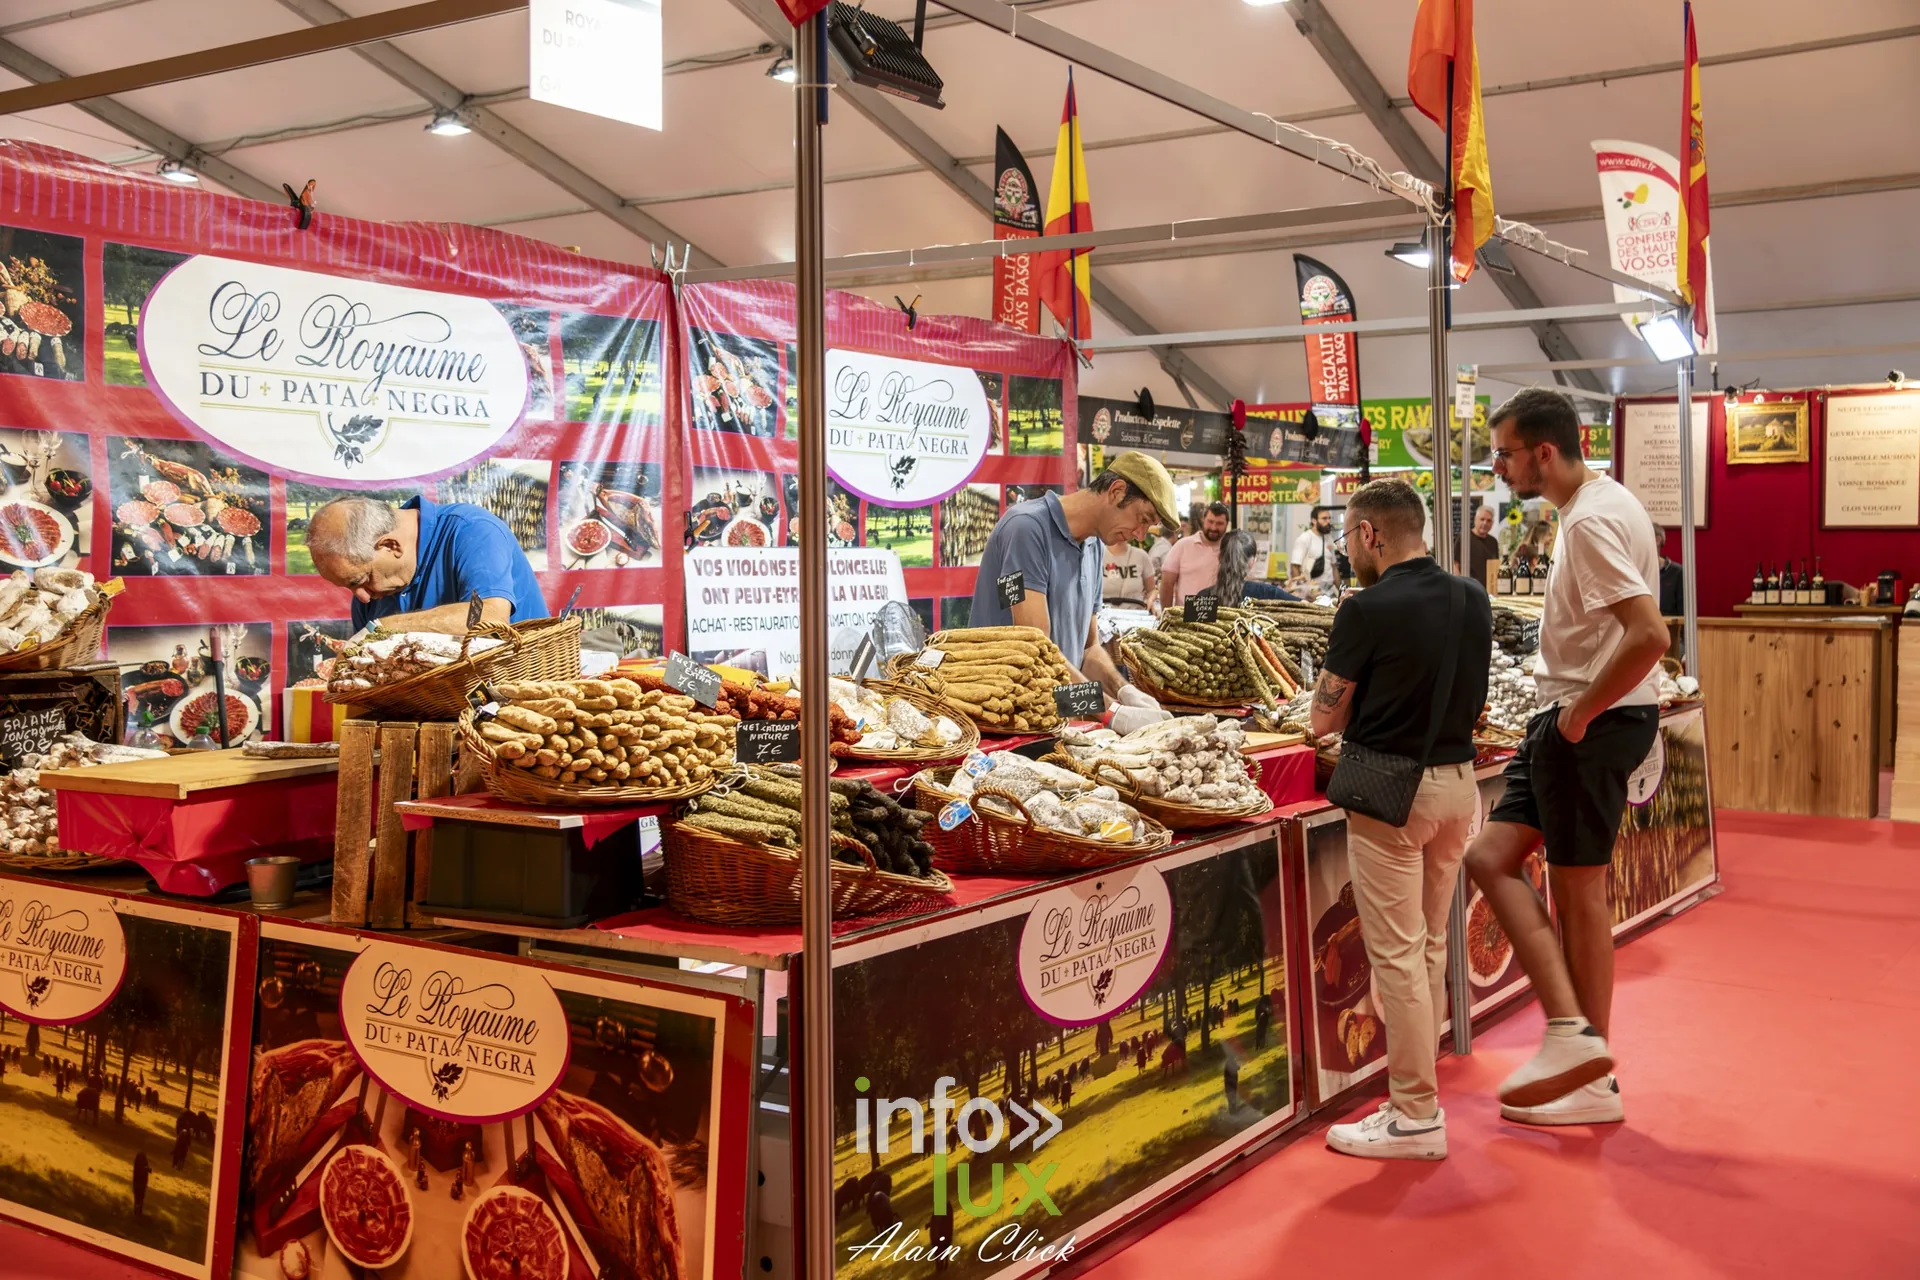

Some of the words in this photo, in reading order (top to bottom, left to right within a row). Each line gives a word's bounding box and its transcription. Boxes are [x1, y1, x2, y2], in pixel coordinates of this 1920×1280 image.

[543, 28, 562, 48] DU
[1599, 157, 1657, 172] www.cdhv.fr
[1616, 230, 1677, 247] CONFISER
[1618, 246, 1640, 258] DES
[1642, 240, 1677, 255] HAUT
[1620, 253, 1677, 271] VOSGE
[198, 280, 284, 361] Le
[295, 293, 488, 406] Royaume
[1339, 368, 1350, 393] PAYS
[200, 371, 251, 399] DU
[281, 379, 358, 408] PATA
[387, 389, 490, 418] NEGRA
[829, 364, 871, 420] Le
[876, 370, 971, 450] Royaume
[830, 428, 854, 446] DU
[867, 431, 905, 451] PATA
[919, 436, 969, 456] NEGRA
[1379, 438, 1392, 450] RY
[1236, 490, 1300, 503] EMPORTER
[694, 559, 722, 576] VOS
[727, 559, 786, 576] VIOLONS
[789, 560, 800, 576] E
[829, 559, 888, 576] LONCELLES
[702, 587, 730, 605] ONT
[734, 586, 800, 604] PEUT-ETR
[832, 585, 847, 601] LA
[851, 584, 889, 601] VALEUR
[691, 617, 727, 633] ACHAT
[734, 615, 800, 632] RESTAURATIO
[1532, 636, 1539, 646] 3
[831, 648, 855, 661] donn
[1069, 688, 1097, 699] EXTRA
[749, 732, 790, 742] NATURE
[1039, 906, 1075, 963] Le
[1077, 886, 1156, 964] Royaume
[16, 900, 106, 971] Royaume
[8, 951, 41, 972] PATA
[52, 960, 103, 985] NEGRA
[1040, 967, 1062, 989] DU
[1072, 953, 1104, 977] PATA
[1114, 934, 1157, 962] NEGRA
[366, 961, 412, 1018] Le
[416, 970, 540, 1057] Royaume
[365, 1023, 391, 1044] DU
[406, 1031, 450, 1057] PATA
[466, 1044, 536, 1076] NEGRA
